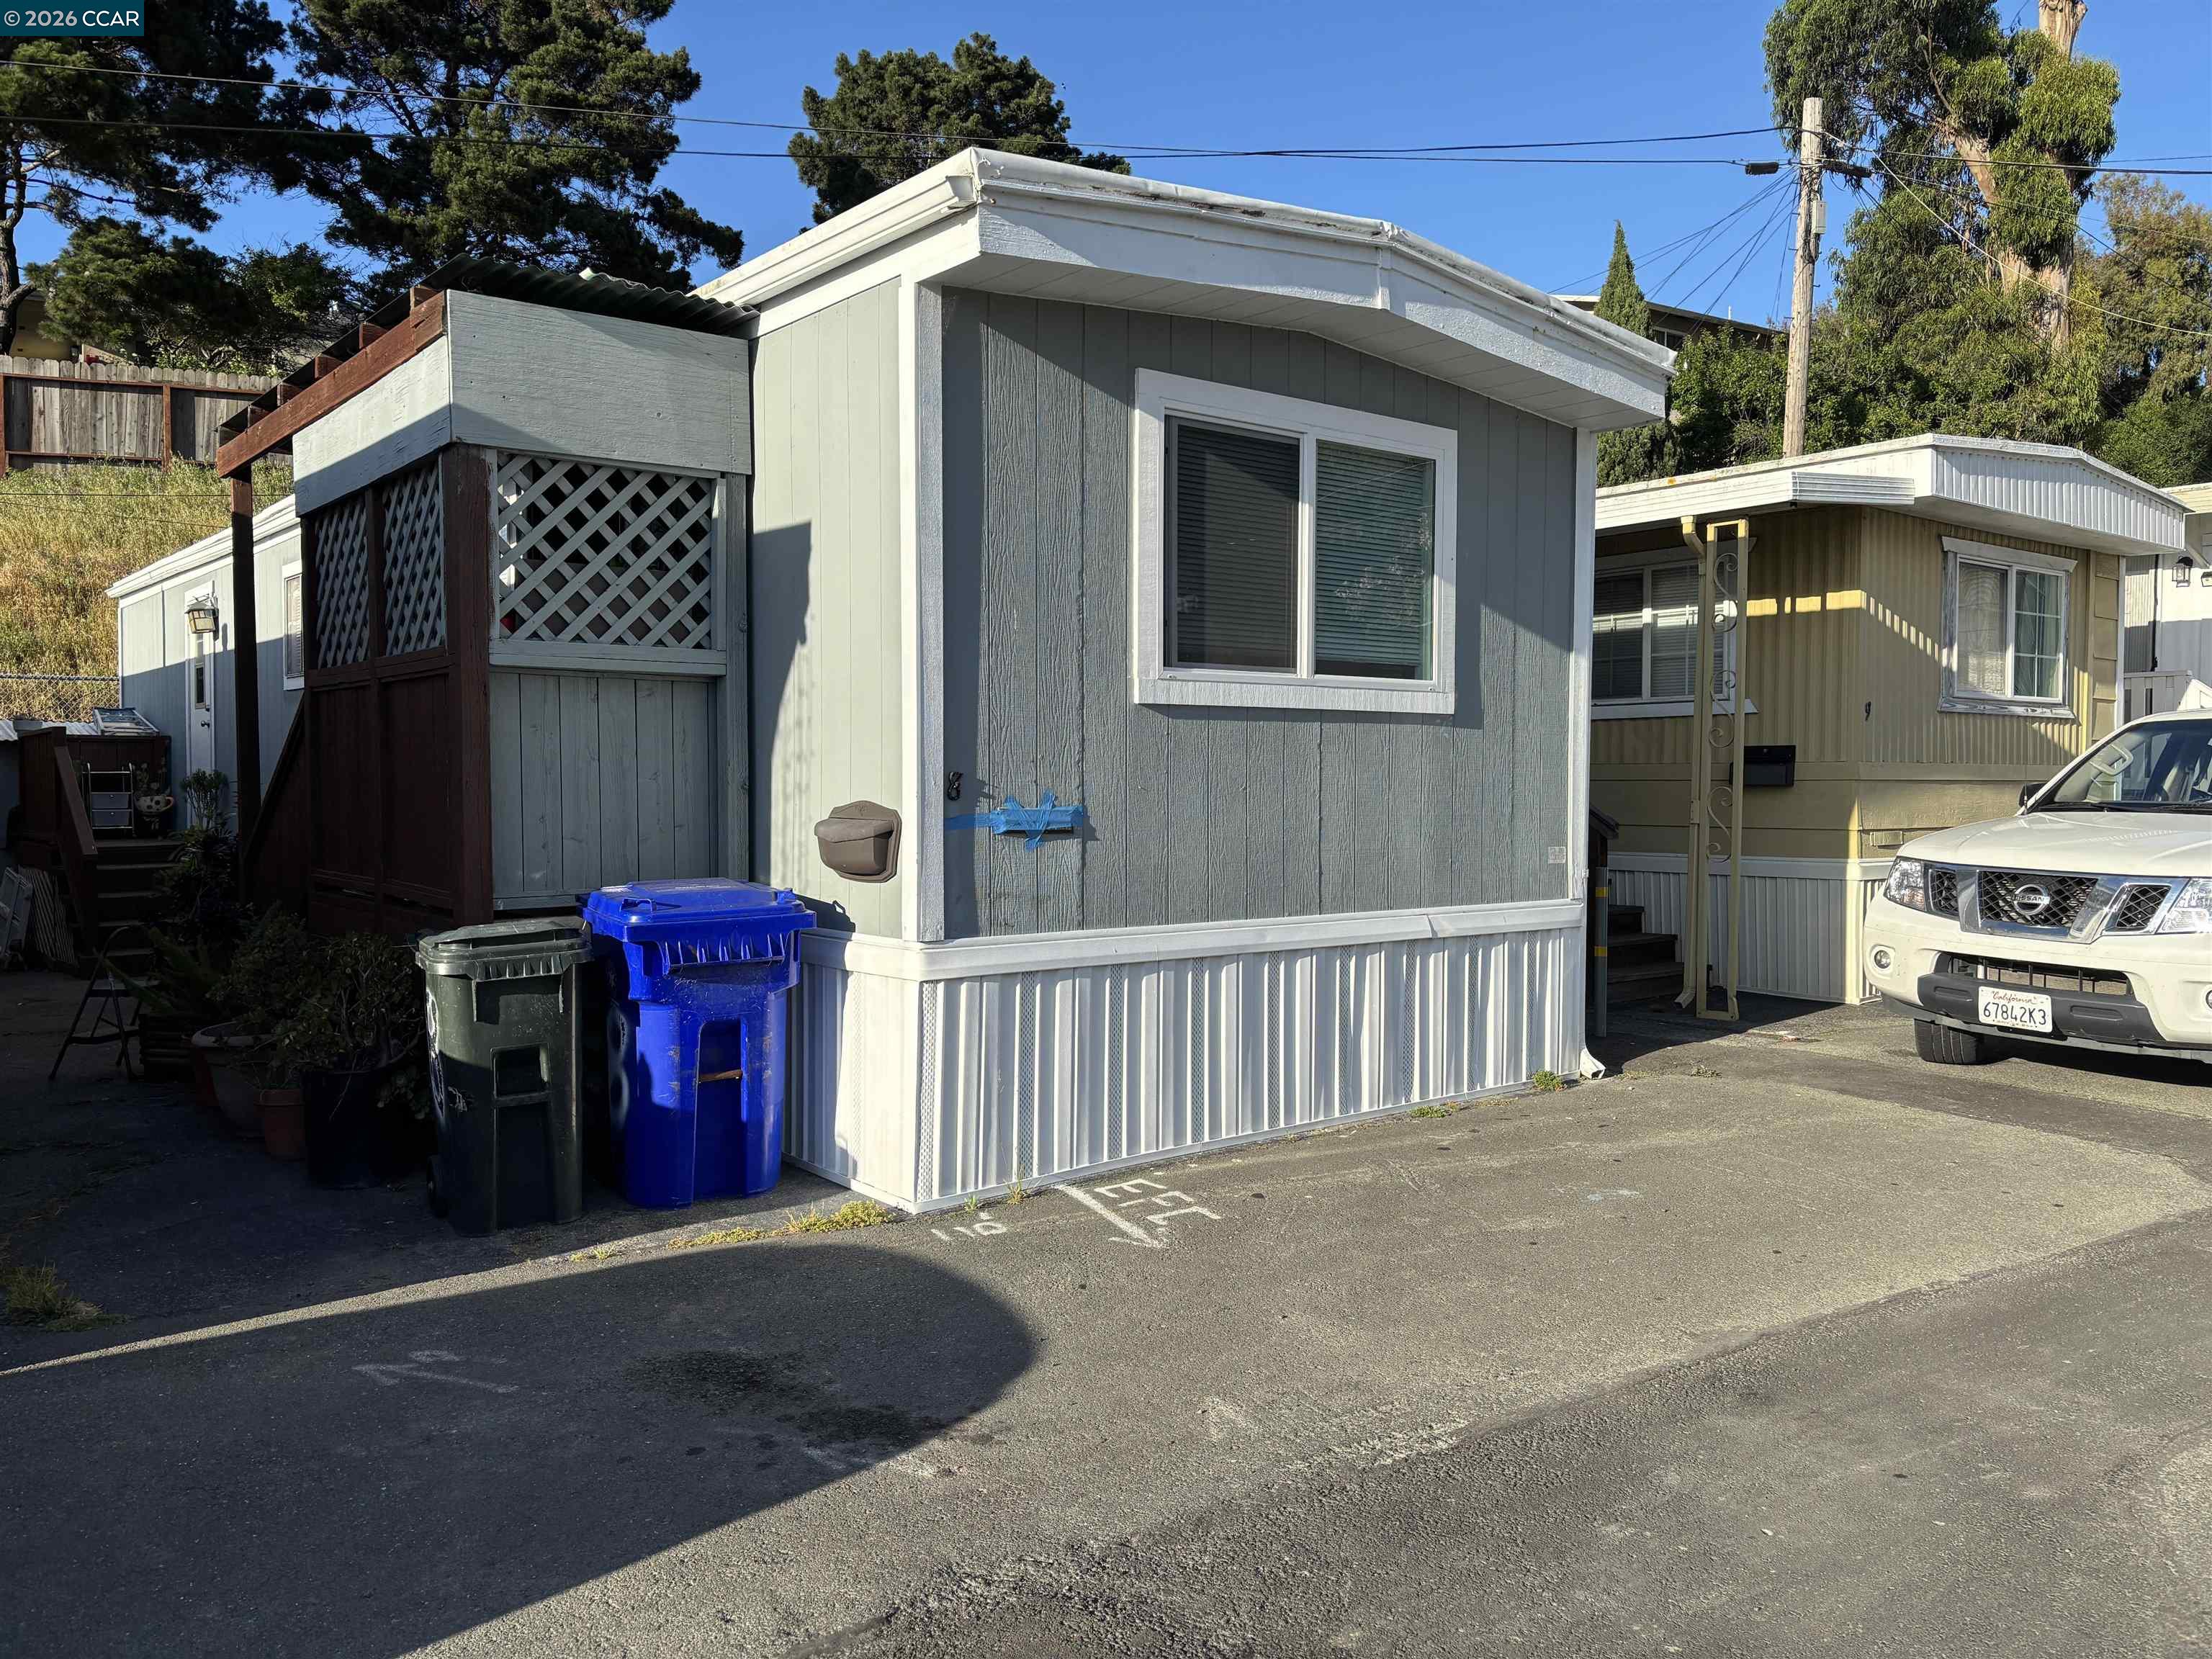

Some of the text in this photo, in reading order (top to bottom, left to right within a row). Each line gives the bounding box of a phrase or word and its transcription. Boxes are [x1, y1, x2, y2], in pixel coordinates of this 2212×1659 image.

[2012, 894, 2049, 904] NISSAN
[1992, 991, 2037, 1003] California
[1983, 1002, 2046, 1025] 67842K3
